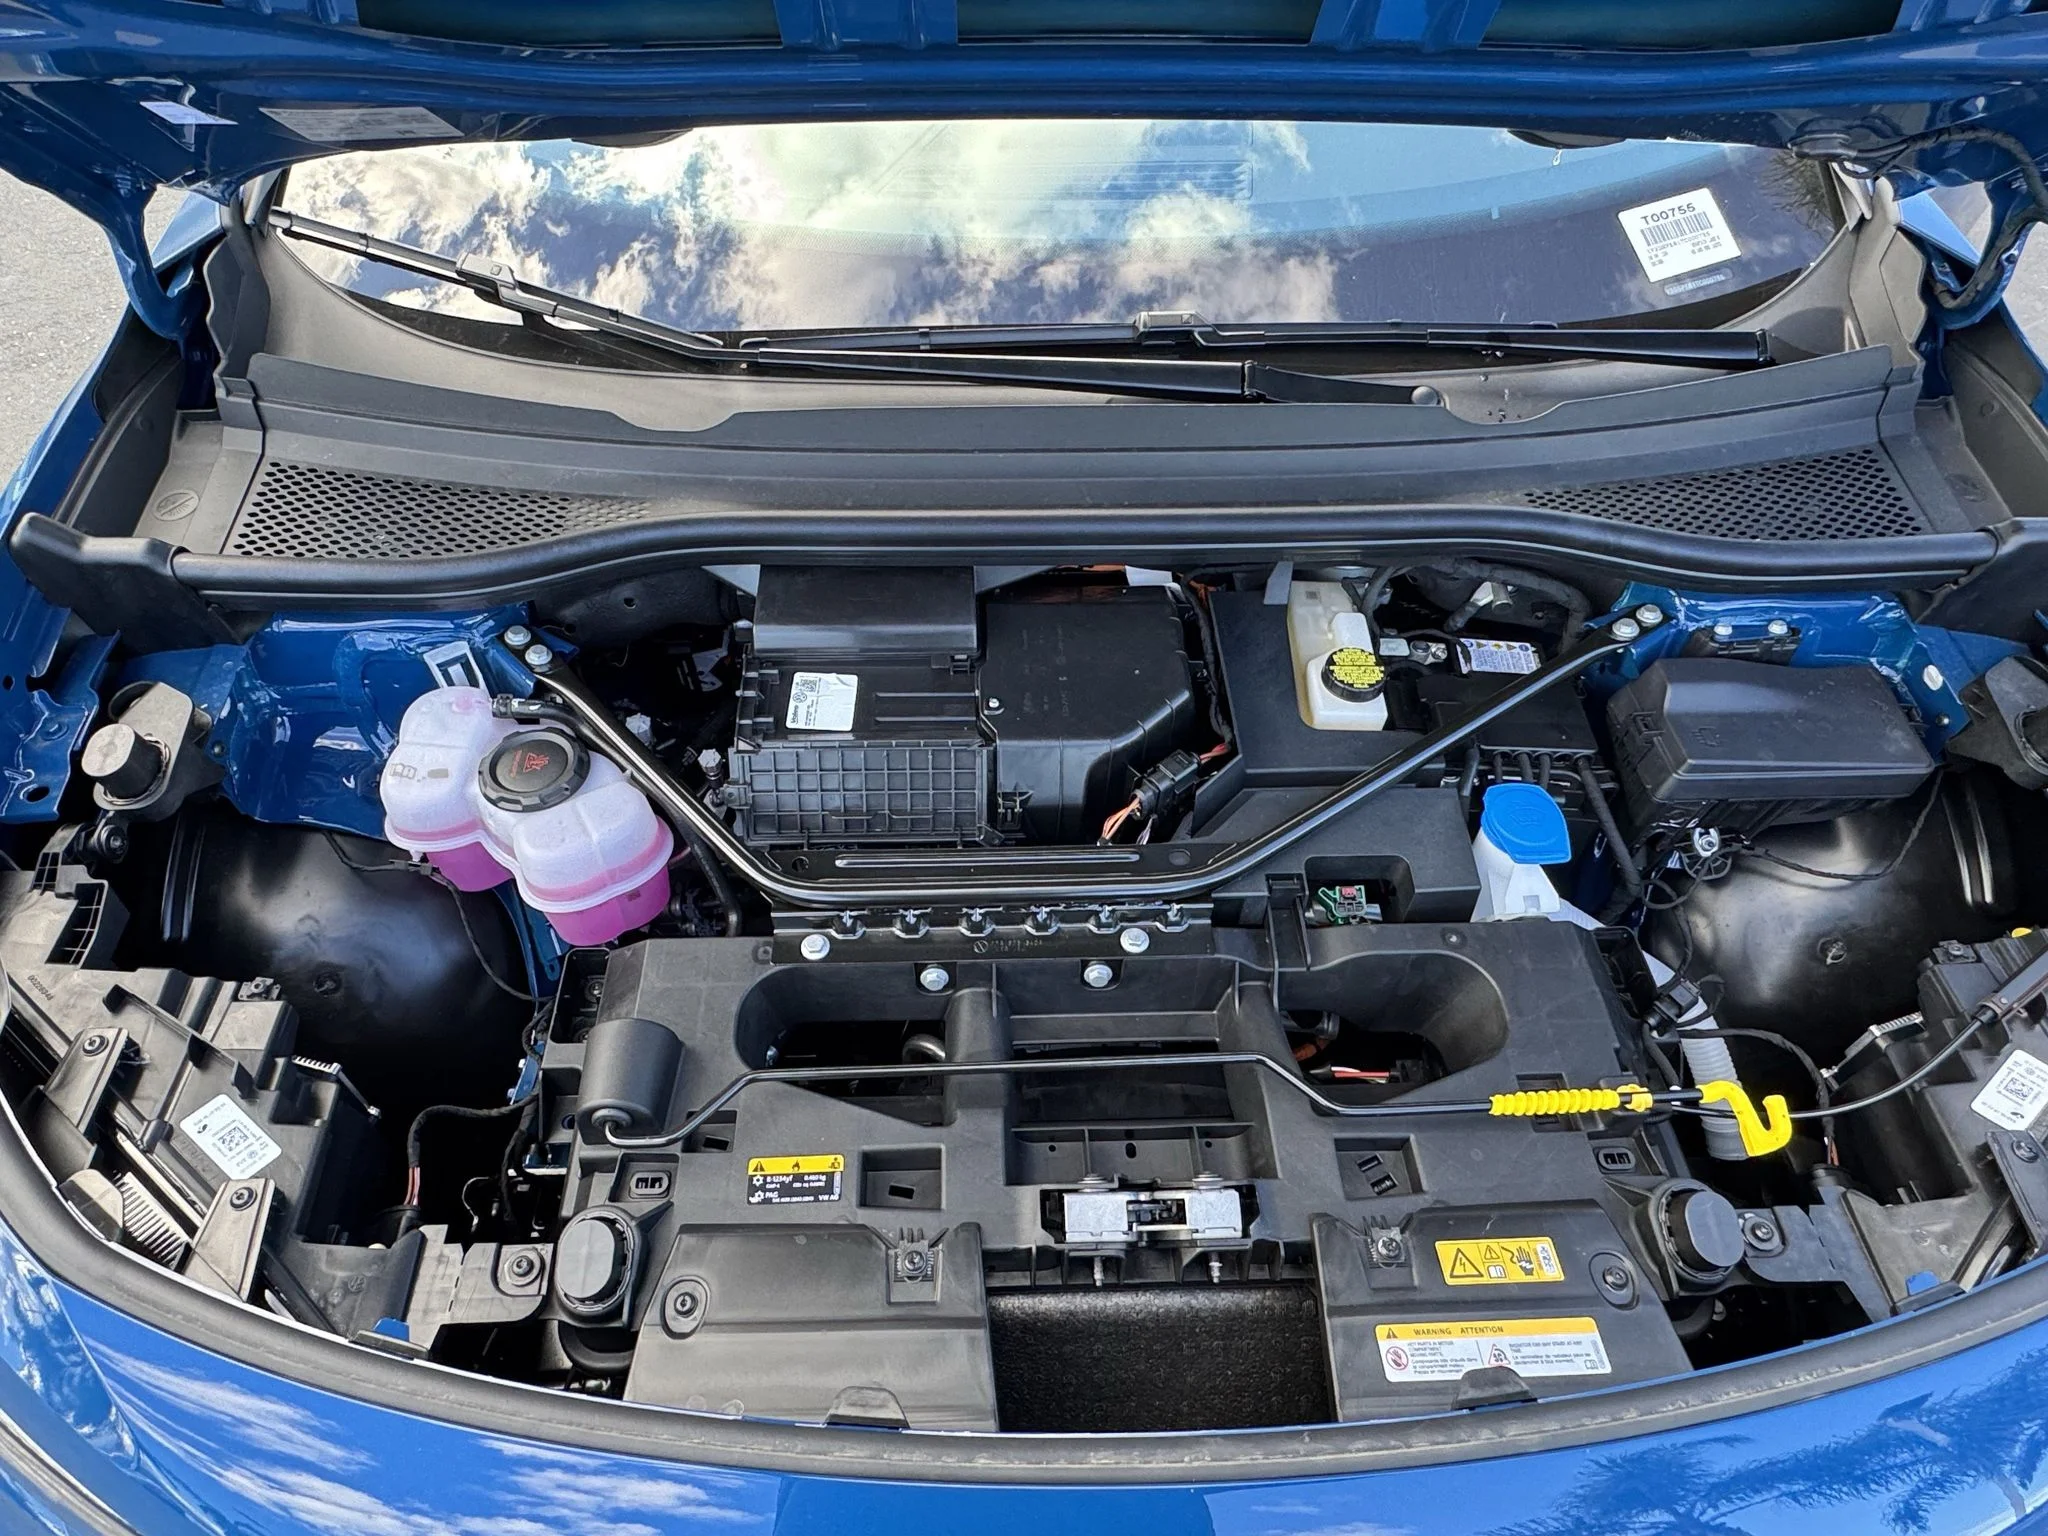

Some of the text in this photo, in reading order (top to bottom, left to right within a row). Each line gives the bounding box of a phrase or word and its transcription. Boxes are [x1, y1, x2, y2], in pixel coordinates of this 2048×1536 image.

[1640, 202, 1696, 226] T00755
[1413, 1325, 1504, 1336] WARNING ATTENTION
